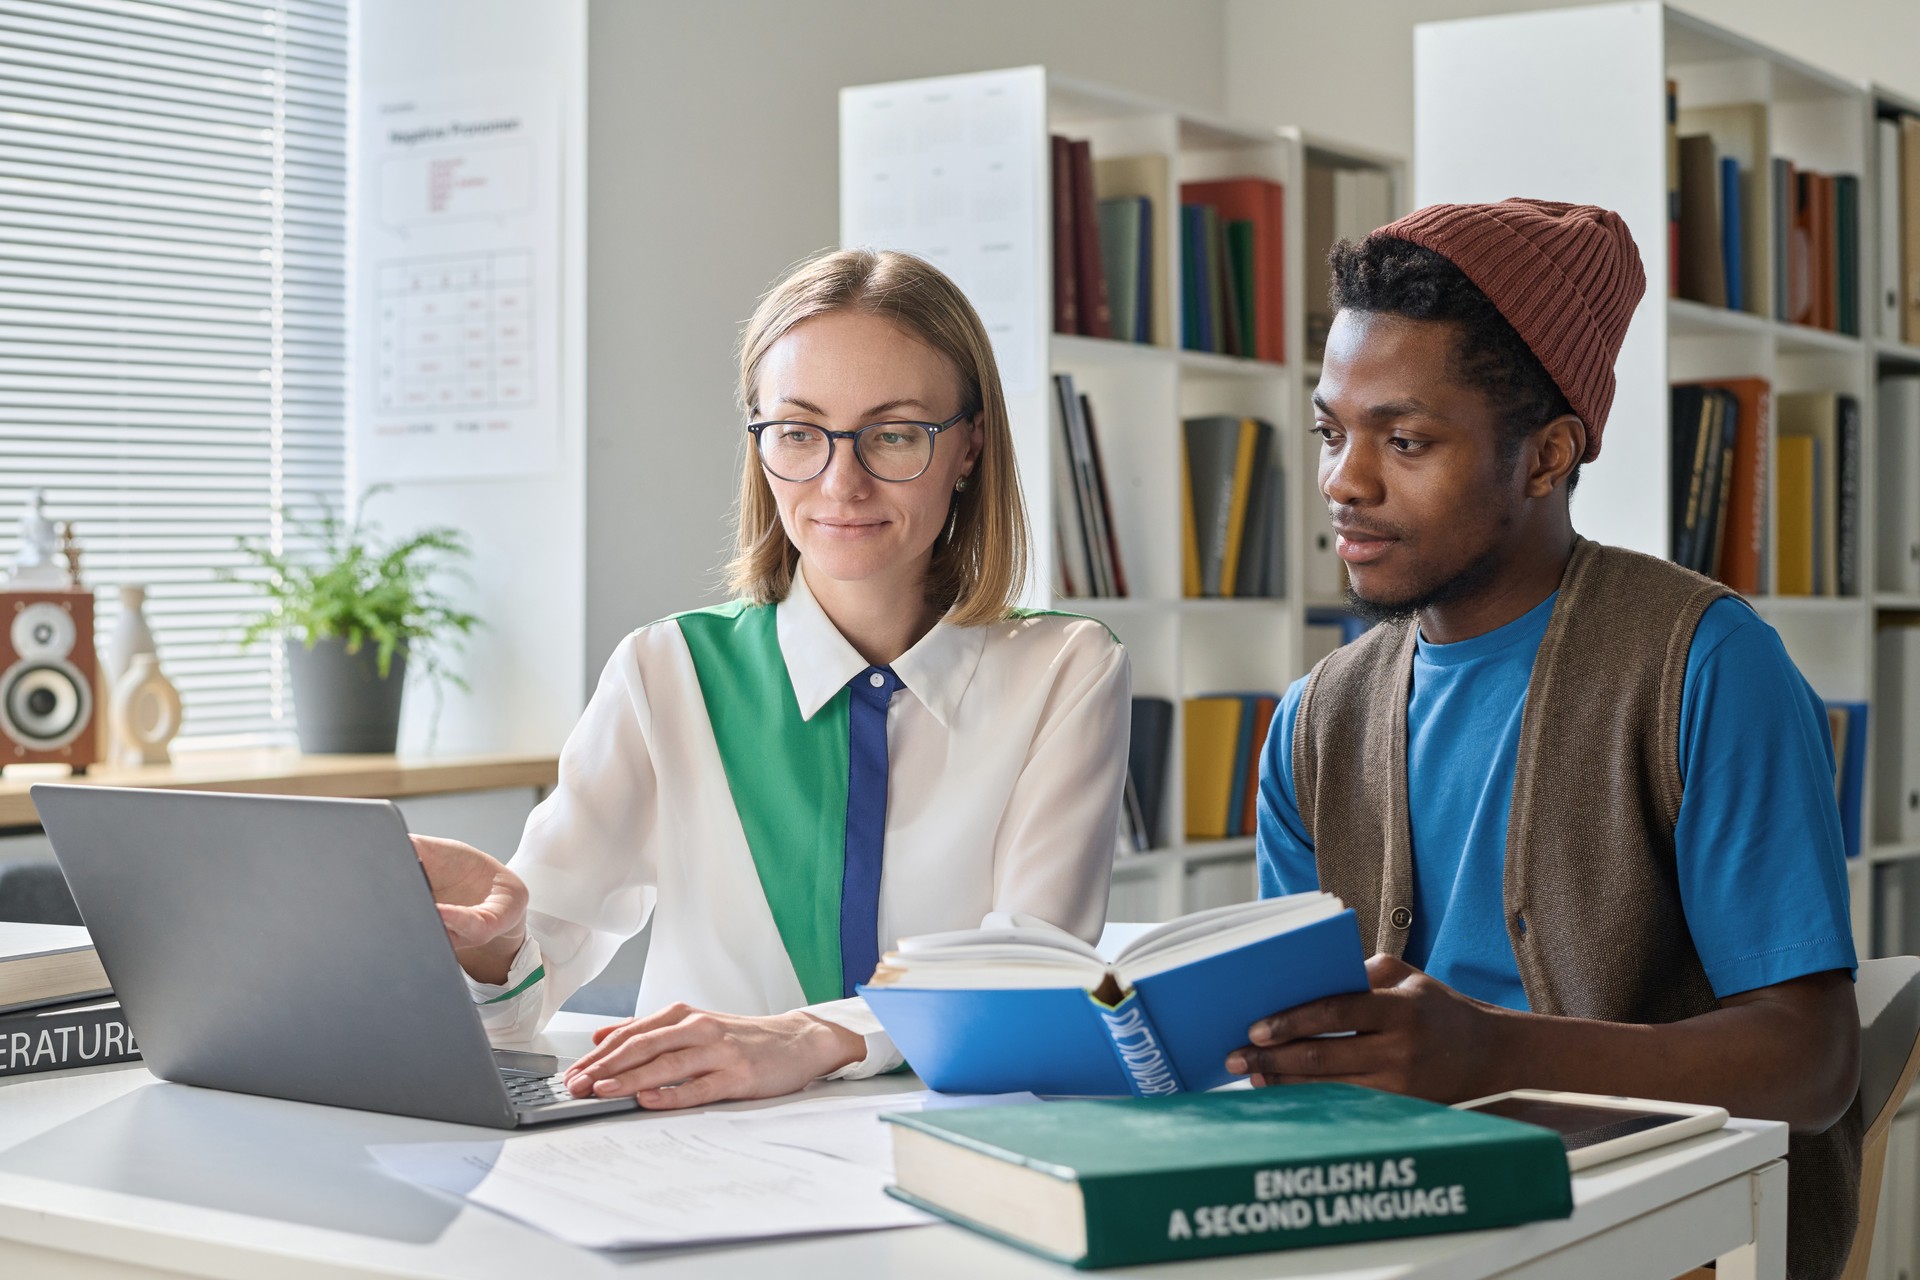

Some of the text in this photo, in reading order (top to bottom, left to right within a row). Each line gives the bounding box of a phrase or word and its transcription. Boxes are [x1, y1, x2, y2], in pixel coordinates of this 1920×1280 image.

[1101, 1007, 1178, 1098] DICTIONAR
[1255, 1157, 1417, 1200] ENGLISH AS
[1168, 1185, 1467, 1240] A SECOND LANGUAGE
